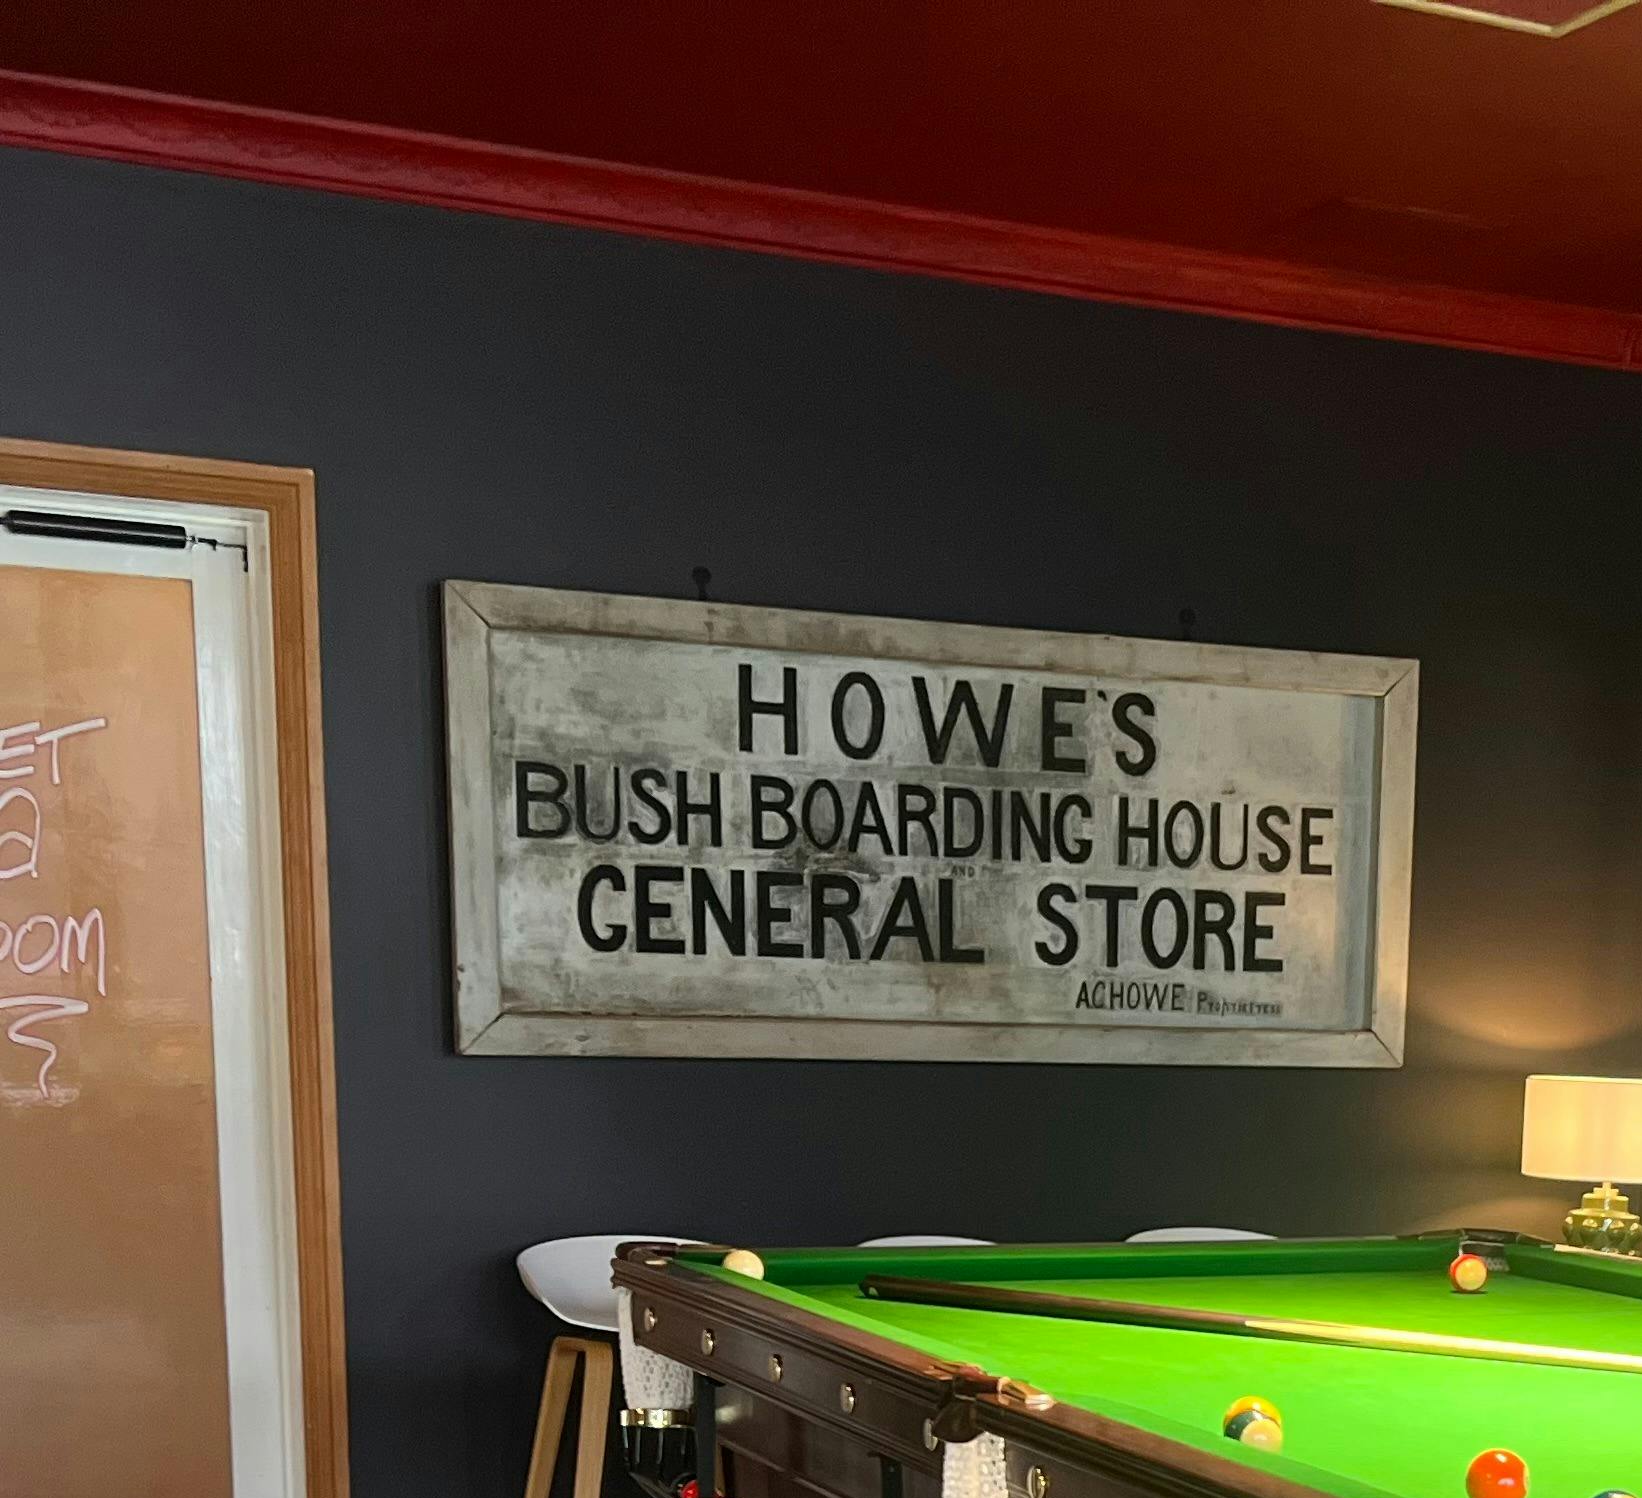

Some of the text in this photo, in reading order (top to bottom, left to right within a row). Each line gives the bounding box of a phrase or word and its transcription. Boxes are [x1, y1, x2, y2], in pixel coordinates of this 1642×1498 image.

[737, 663, 1157, 777] HOWE'S
[515, 761, 1335, 876] BUSH BOARDING HOUSE
[0, 906, 107, 998] OM
[577, 864, 1287, 974] GENERAL STORE
